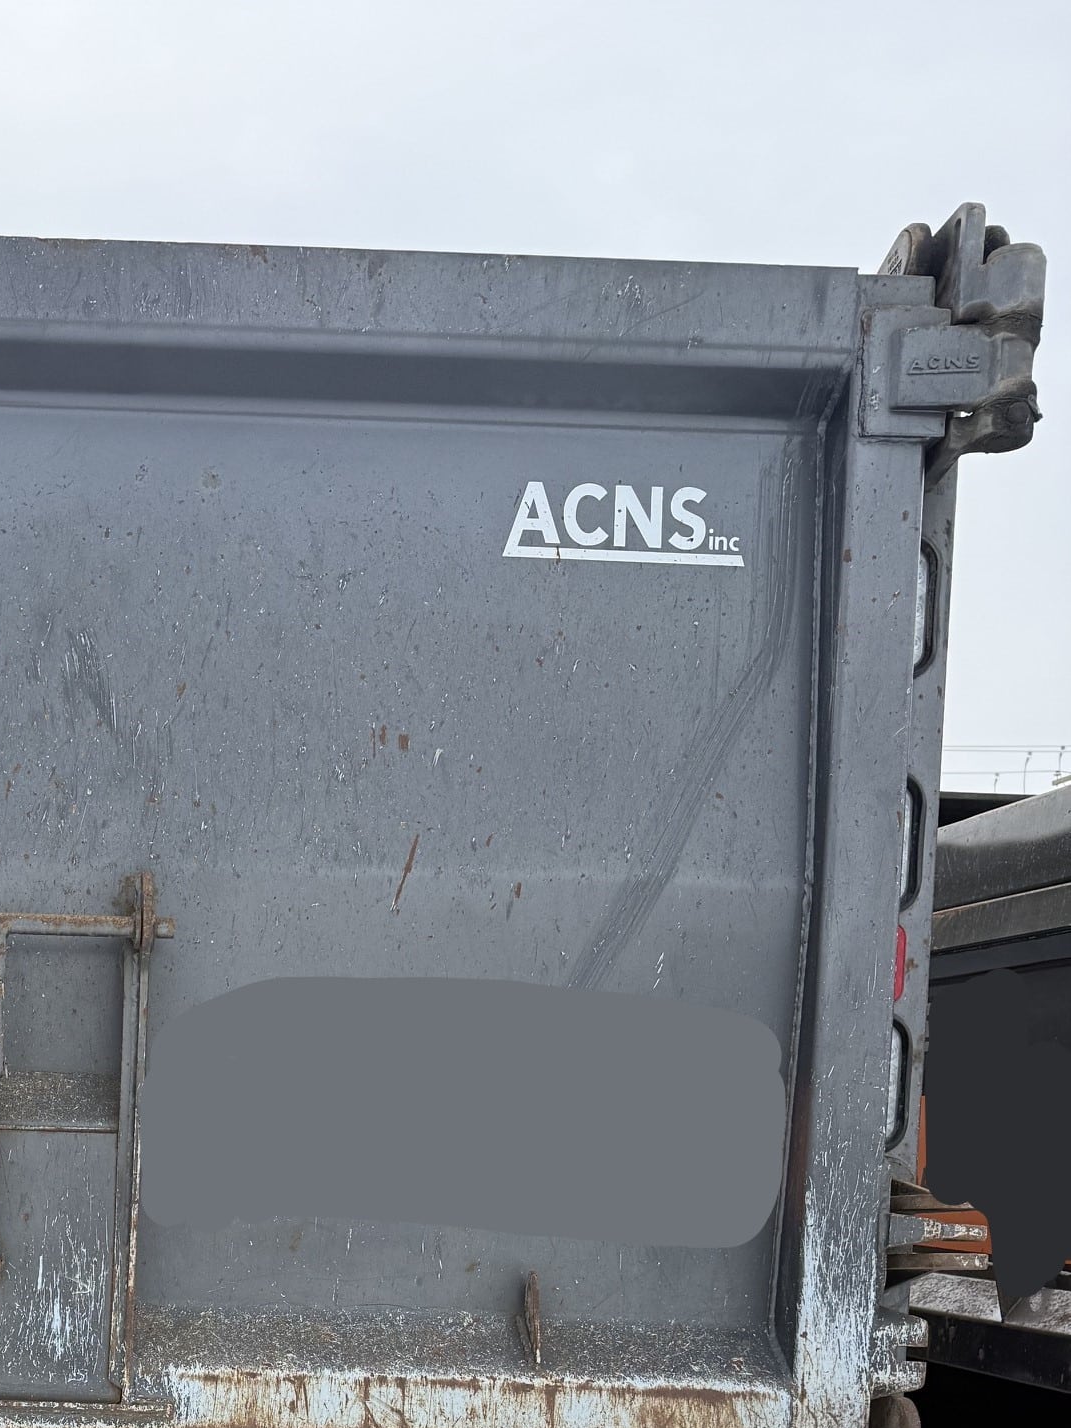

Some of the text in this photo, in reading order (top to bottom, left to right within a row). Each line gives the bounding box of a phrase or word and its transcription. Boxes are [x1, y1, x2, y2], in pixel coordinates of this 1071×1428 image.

[910, 354, 980, 371] ACNS
[502, 481, 740, 557] ACNS inc
